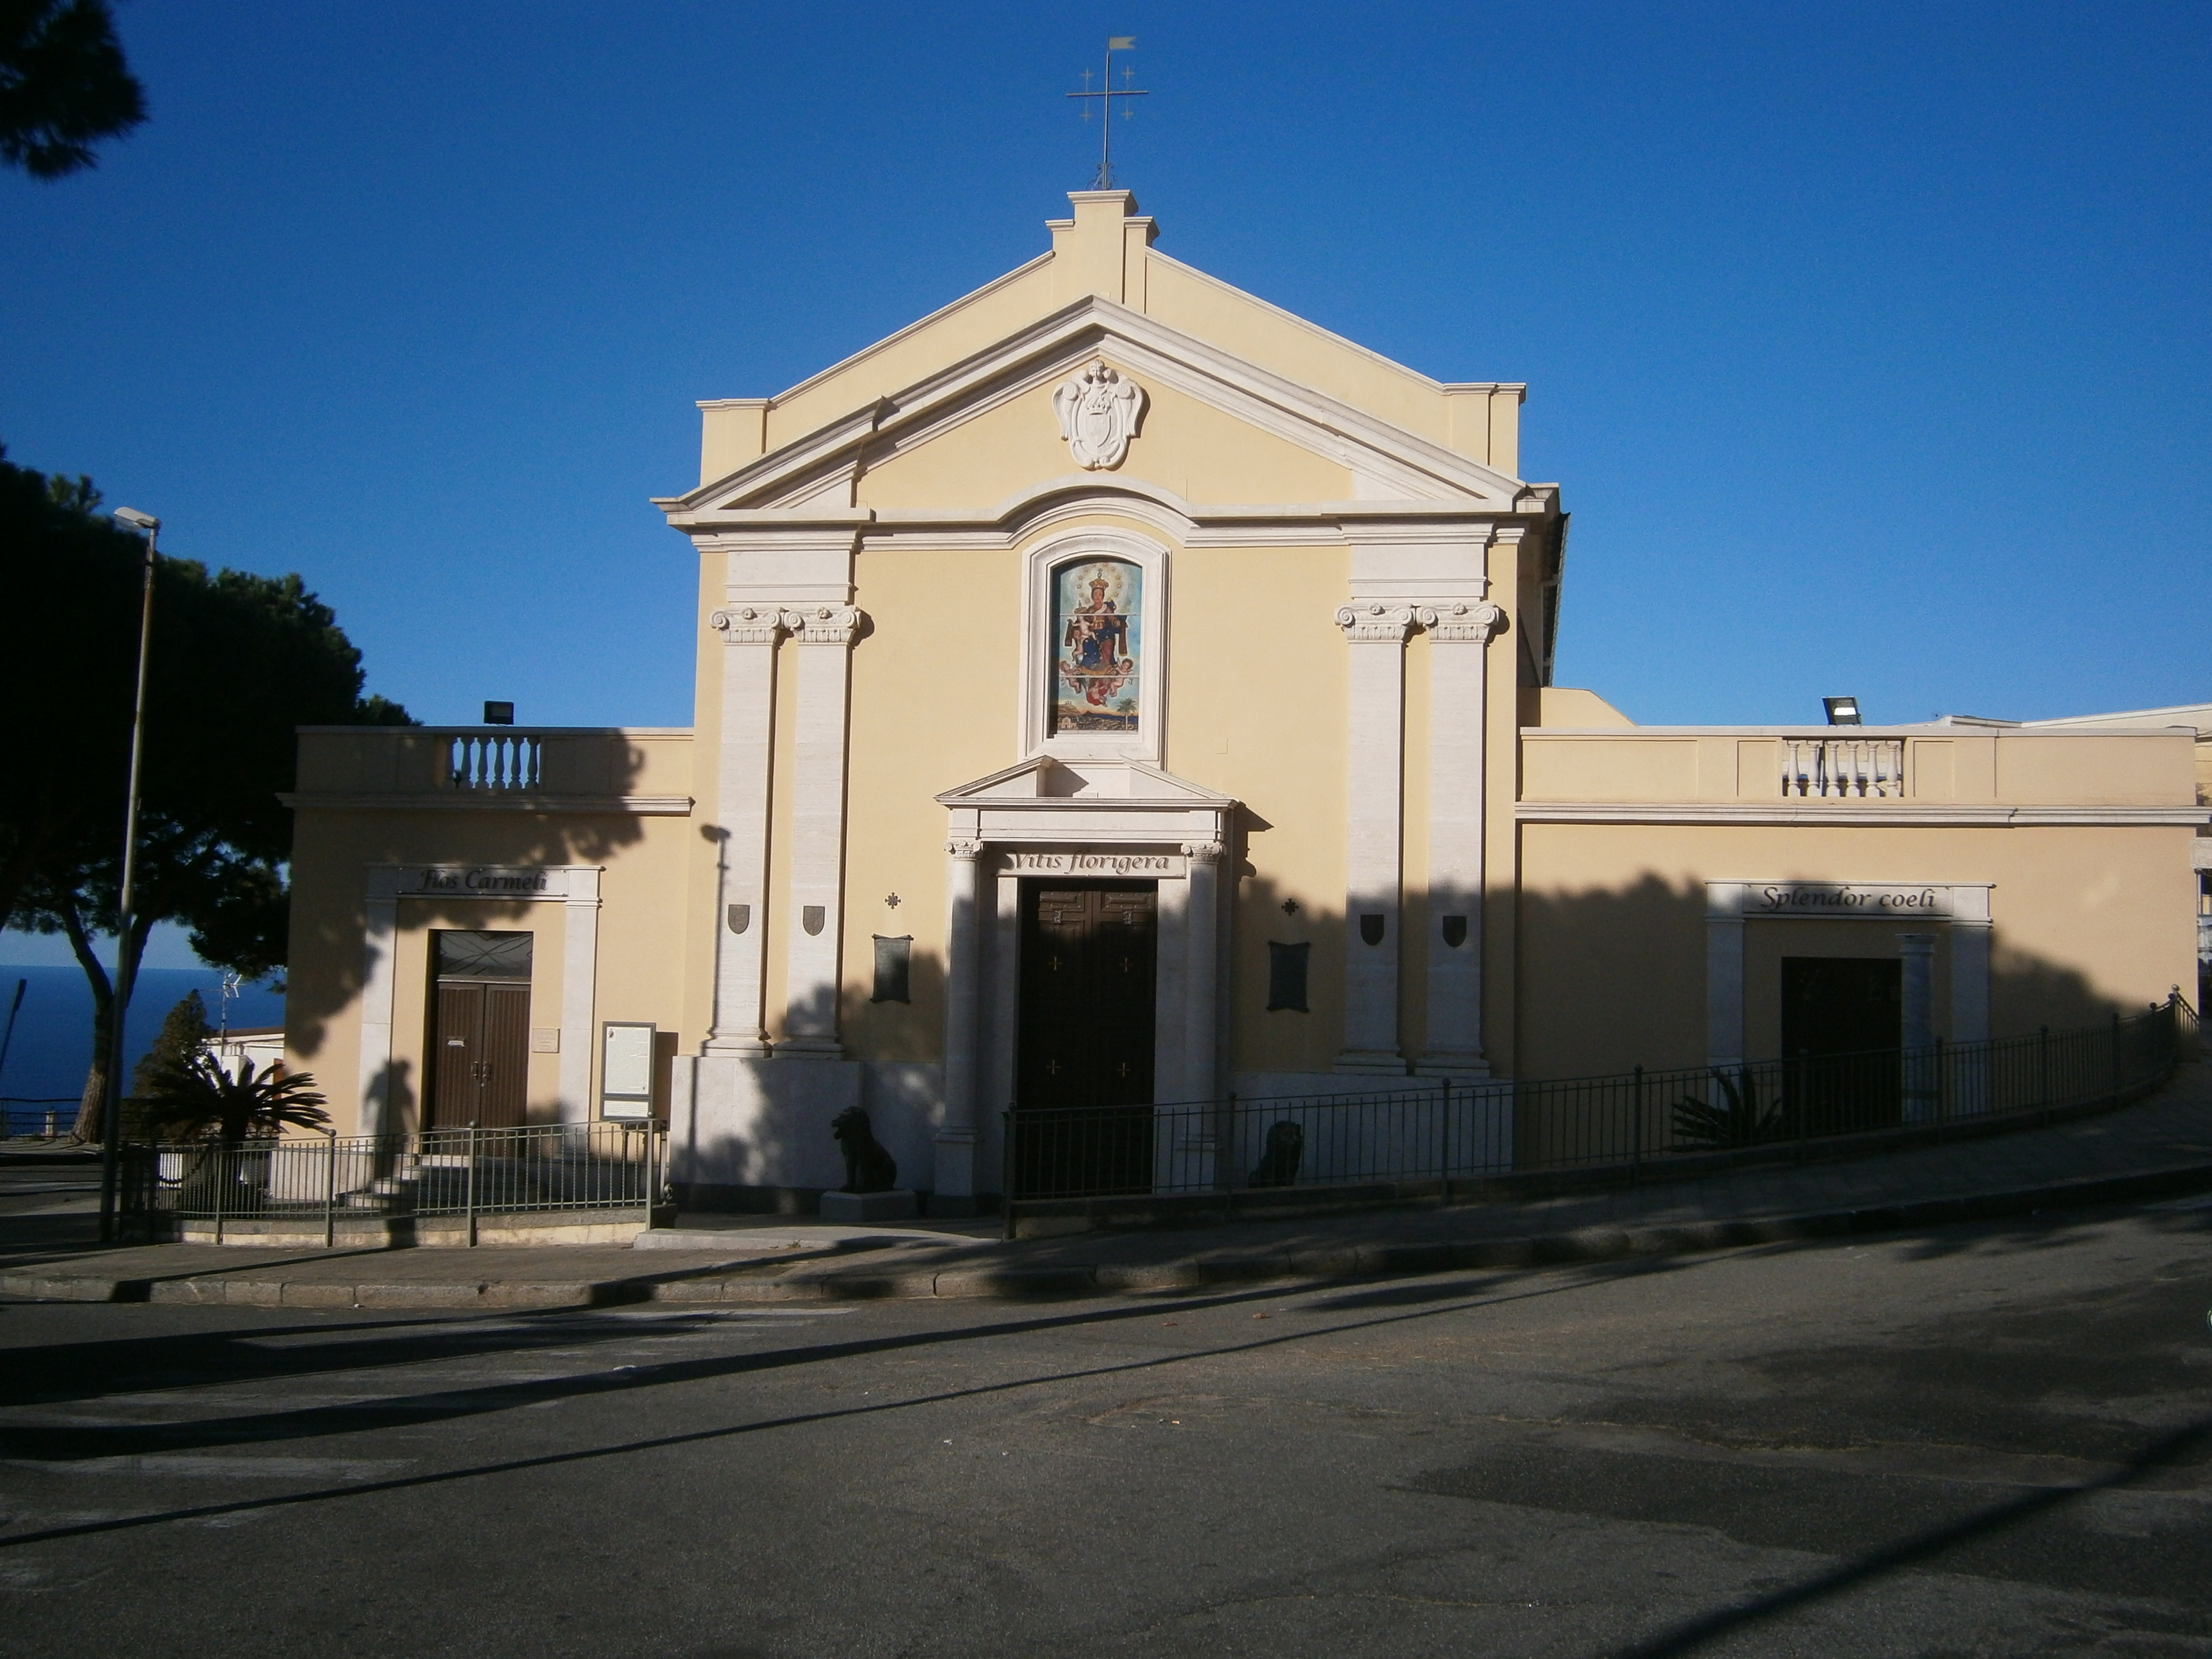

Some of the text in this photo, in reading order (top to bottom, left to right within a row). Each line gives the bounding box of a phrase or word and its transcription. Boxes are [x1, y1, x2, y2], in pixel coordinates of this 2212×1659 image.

[1007, 850, 1170, 874] Vitis florigera
[417, 869, 548, 891] Flos Carmeli
[1761, 886, 1935, 910] Splendor coeli
